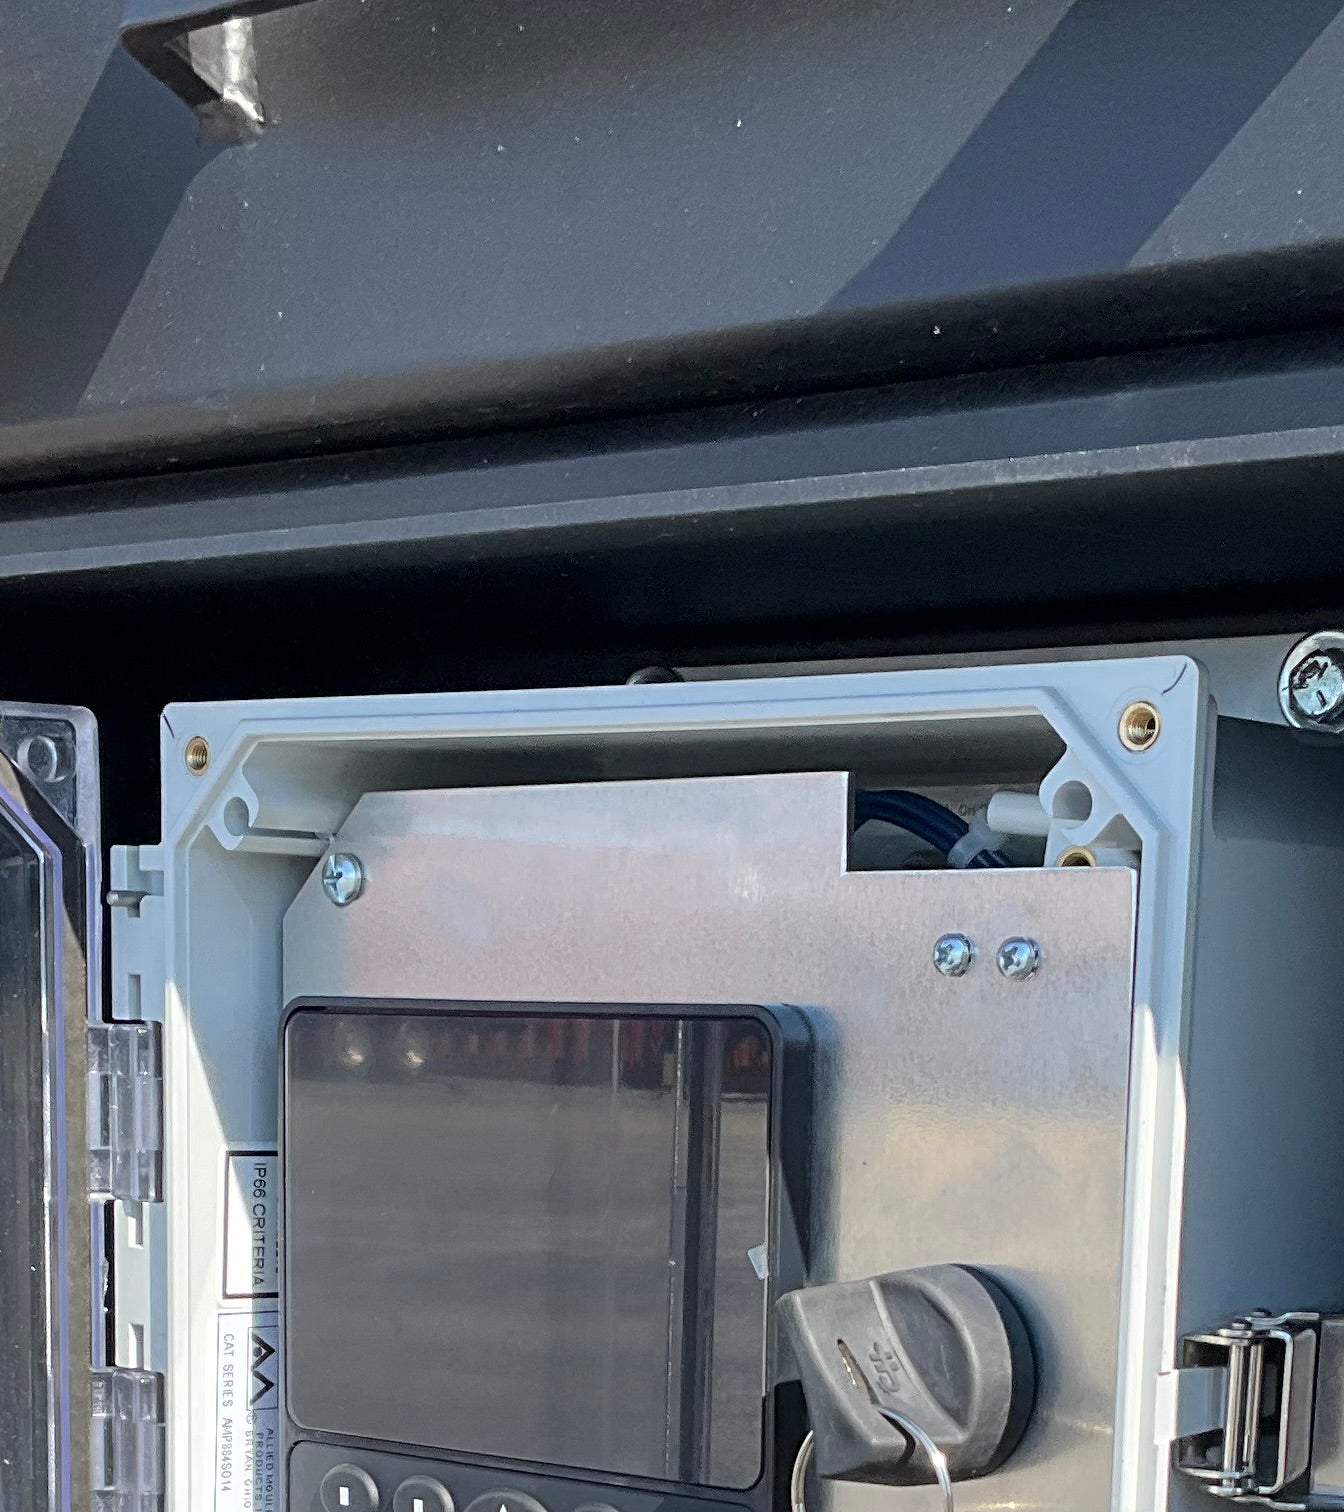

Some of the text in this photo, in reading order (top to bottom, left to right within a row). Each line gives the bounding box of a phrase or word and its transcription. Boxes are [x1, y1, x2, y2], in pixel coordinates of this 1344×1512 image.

[252, 1162, 267, 1287] IP66 CRITERIA
[223, 1333, 235, 1357] CAT
[222, 1363, 235, 1407] SERIES
[265, 1427, 275, 1471] ALLIED
